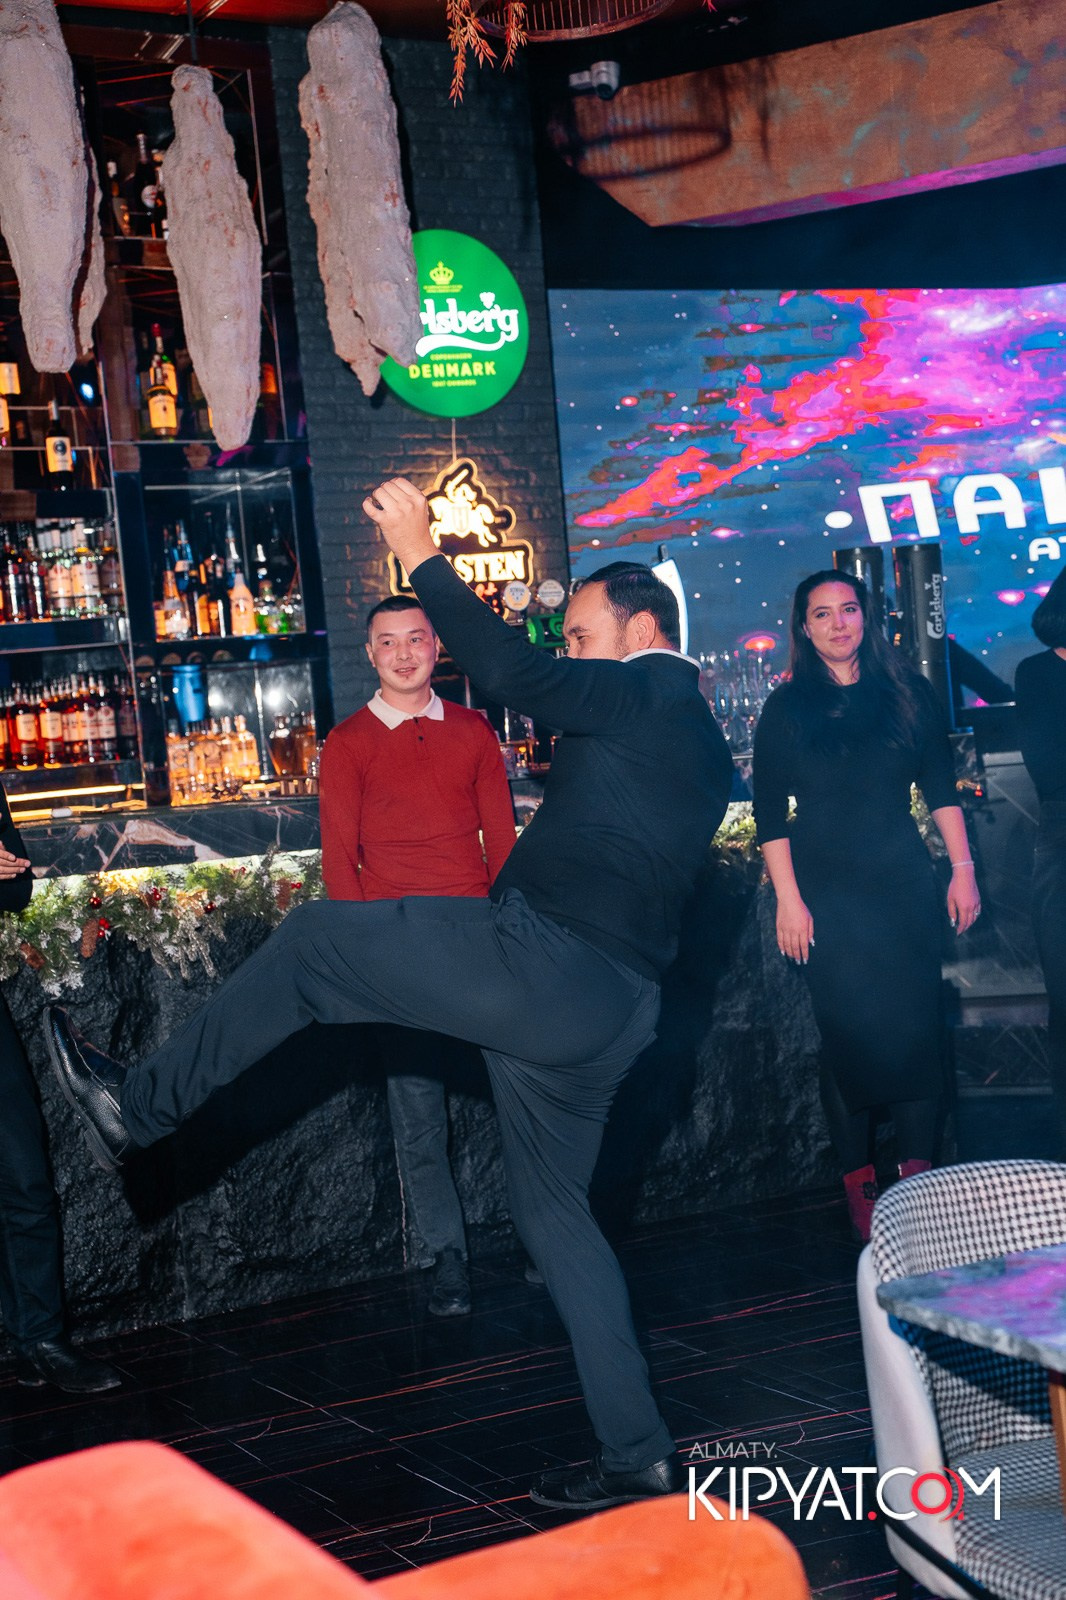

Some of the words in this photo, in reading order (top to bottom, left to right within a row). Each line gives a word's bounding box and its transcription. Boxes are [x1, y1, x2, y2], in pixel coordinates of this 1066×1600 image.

[416, 292, 519, 356] lsberg
[408, 361, 497, 379] DENMARK
[398, 550, 526, 589] STEN
[926, 574, 945, 639] Carlsberg
